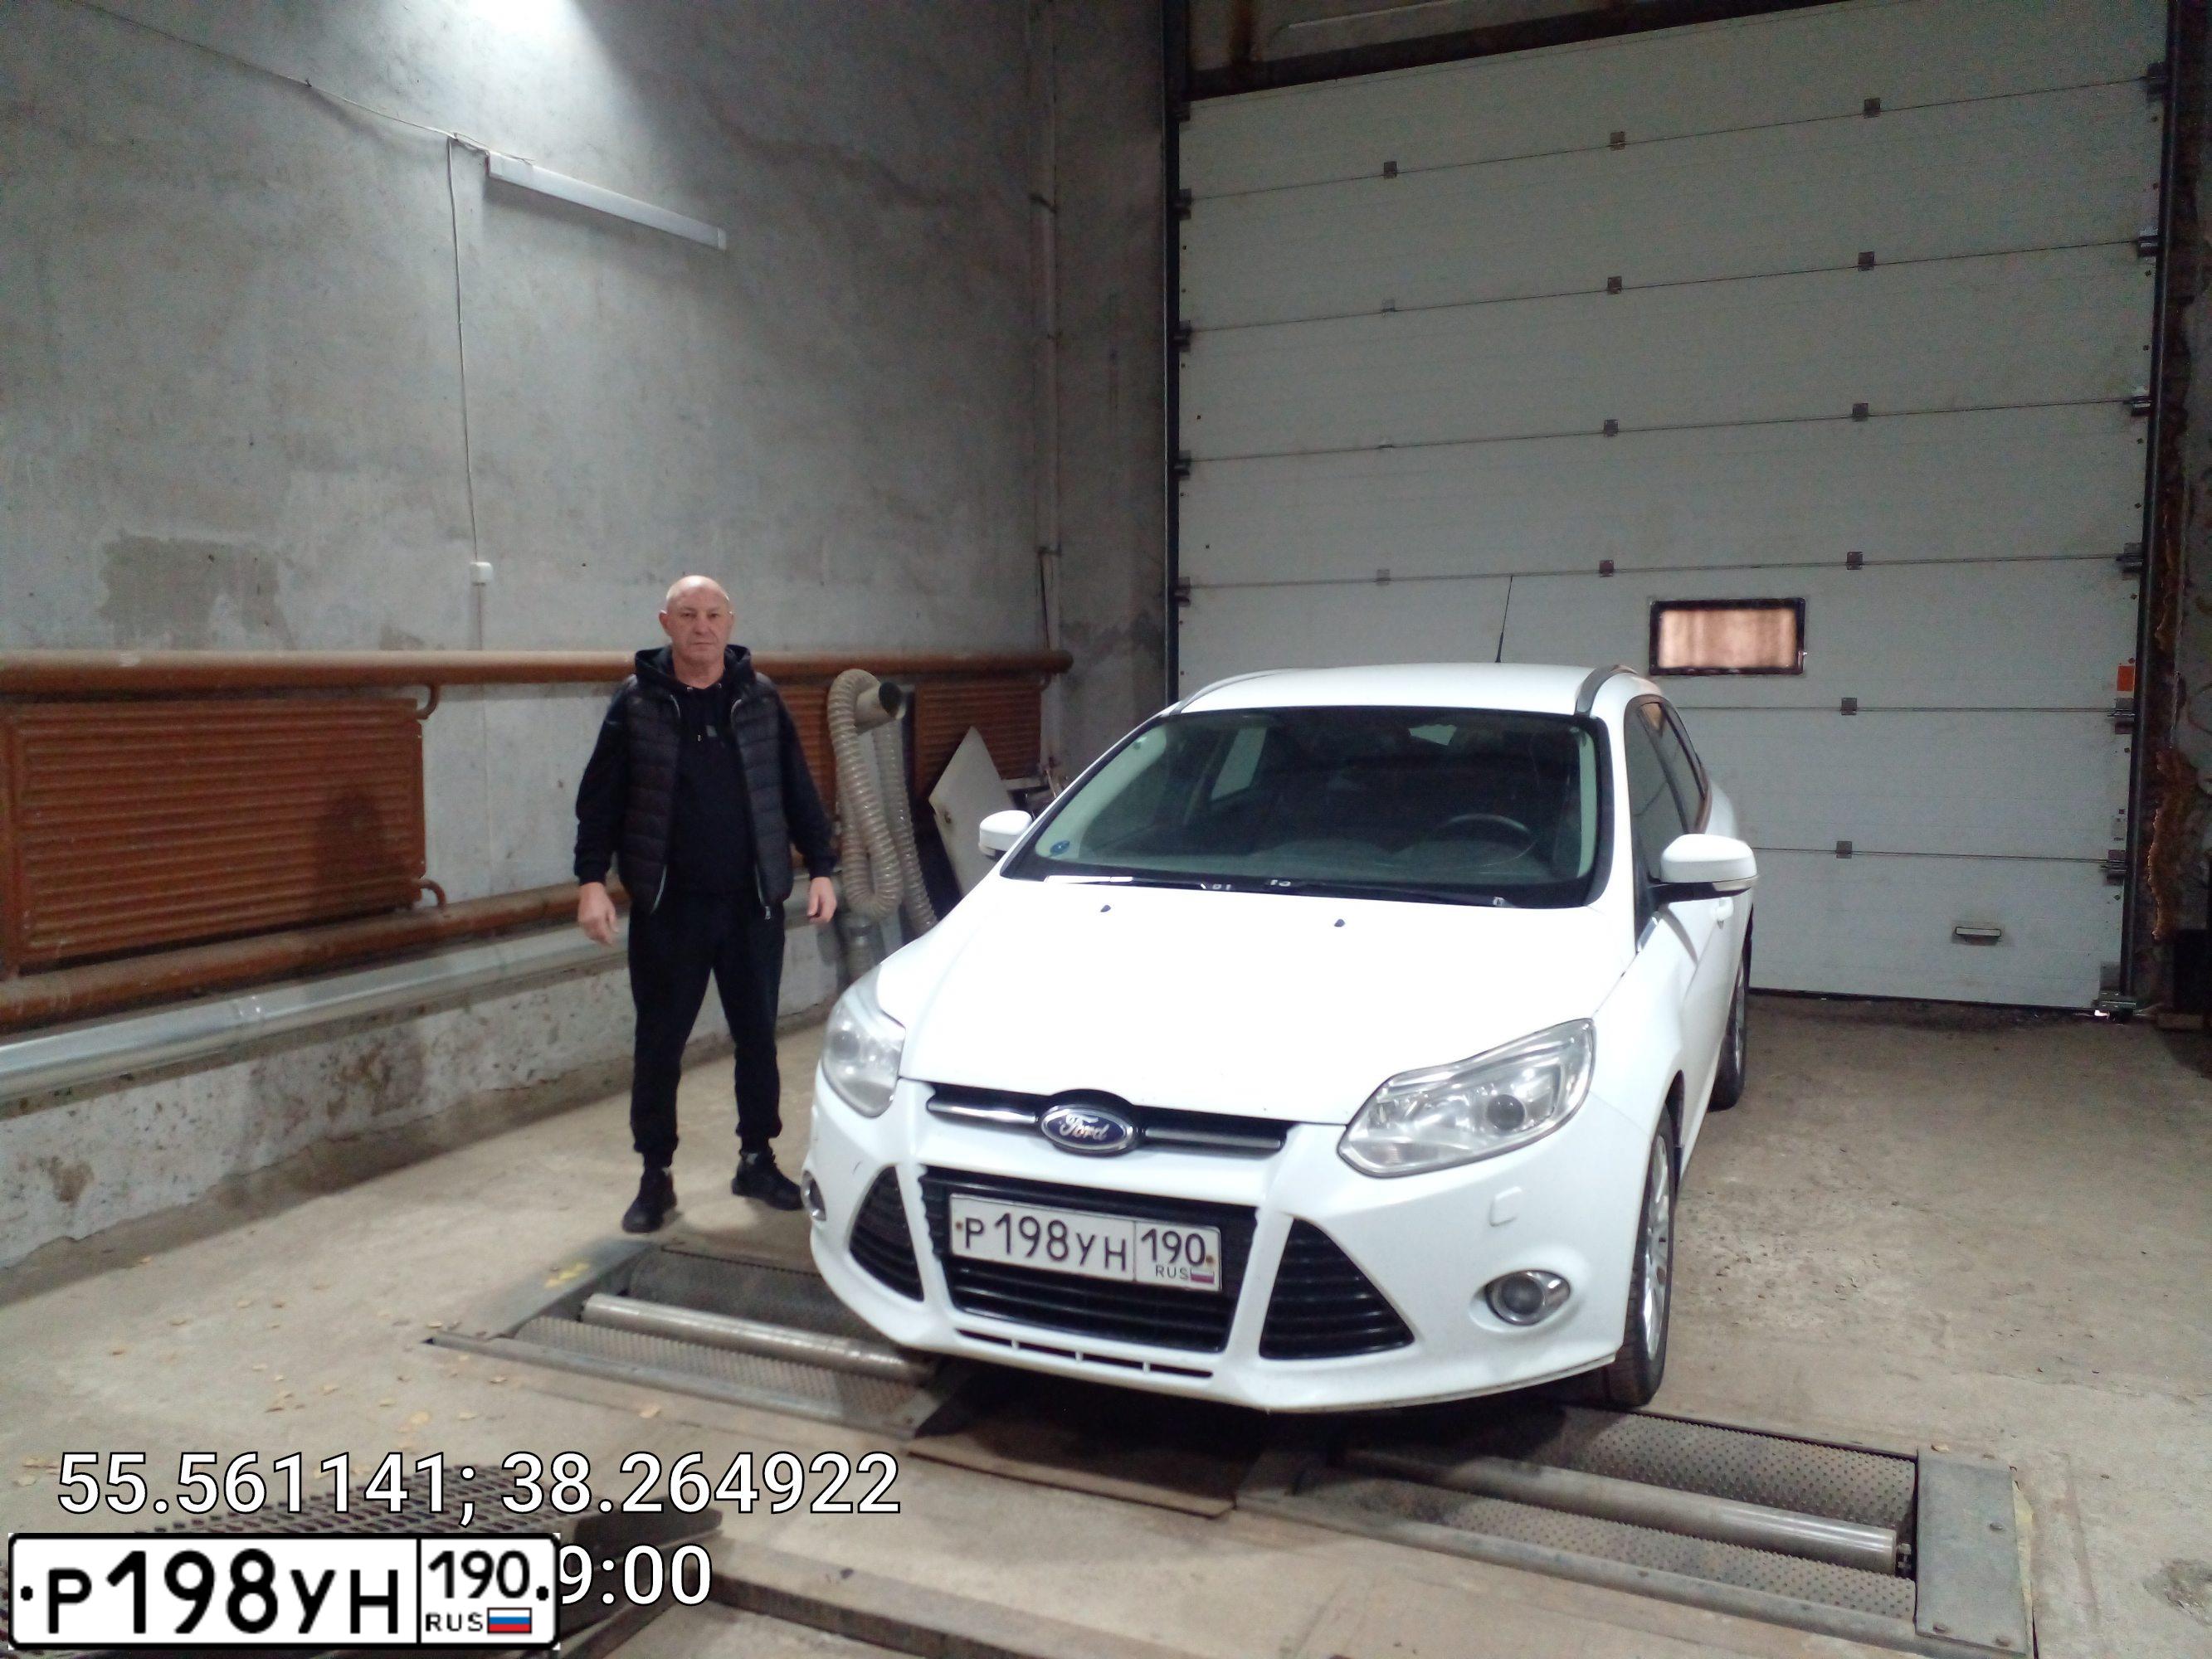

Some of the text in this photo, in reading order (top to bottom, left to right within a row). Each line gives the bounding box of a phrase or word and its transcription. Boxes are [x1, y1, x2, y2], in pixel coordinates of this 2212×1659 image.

[1058, 1113, 1108, 1141] Ford
[965, 1213, 1206, 1272] Р198УН 190
[1155, 1264, 1189, 1280] RUS
